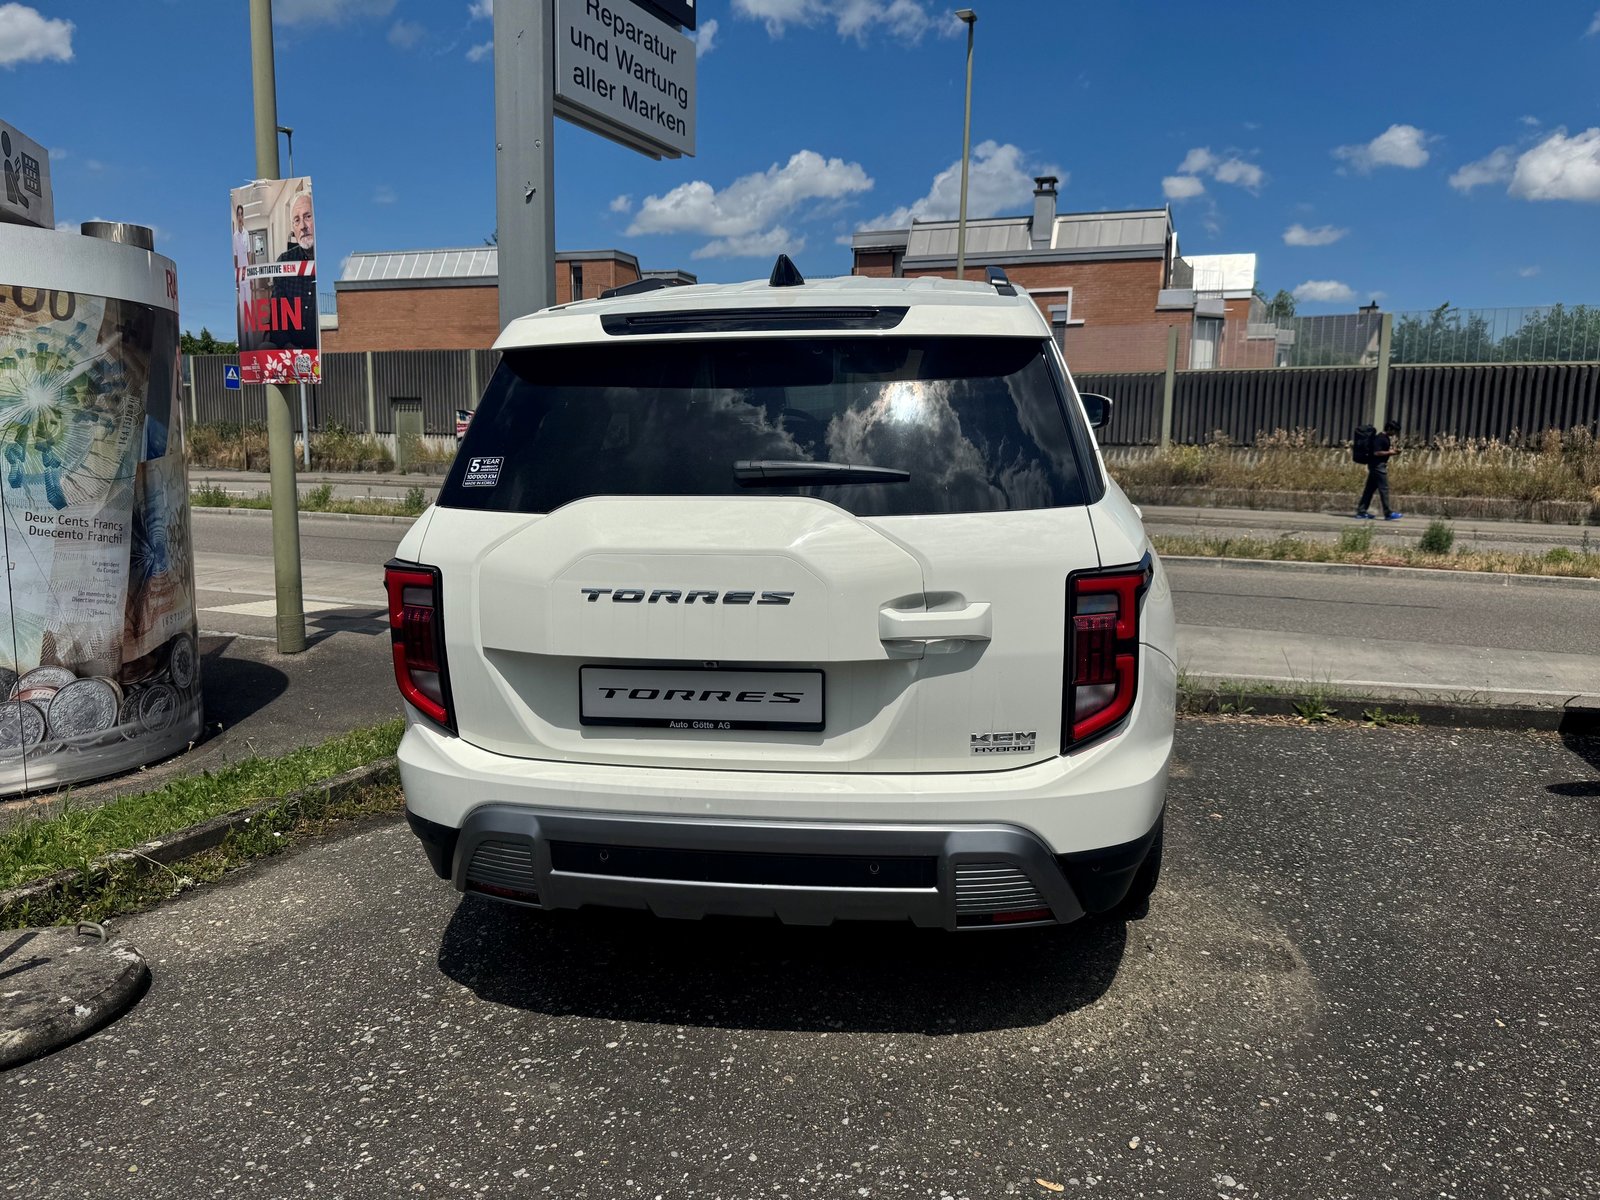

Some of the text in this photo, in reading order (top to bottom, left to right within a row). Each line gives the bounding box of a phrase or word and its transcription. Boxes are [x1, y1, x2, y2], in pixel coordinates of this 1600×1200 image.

[586, 0, 677, 65] Reparatur
[570, 26, 688, 110] und Wartung
[573, 66, 686, 137] aller Marken
[246, 264, 297, 277] CHAOS-INITIATIVE NEIN
[243, 296, 303, 333] NEIN
[470, 459, 481, 472] 5
[25, 511, 123, 532] Deux Cents Francs
[28, 525, 123, 544] Duecento Franchi
[581, 588, 795, 606] TORRES
[598, 687, 804, 704] TORRES
[669, 720, 731, 730] Auto Götte AG
[974, 745, 1031, 753] HYBRID
